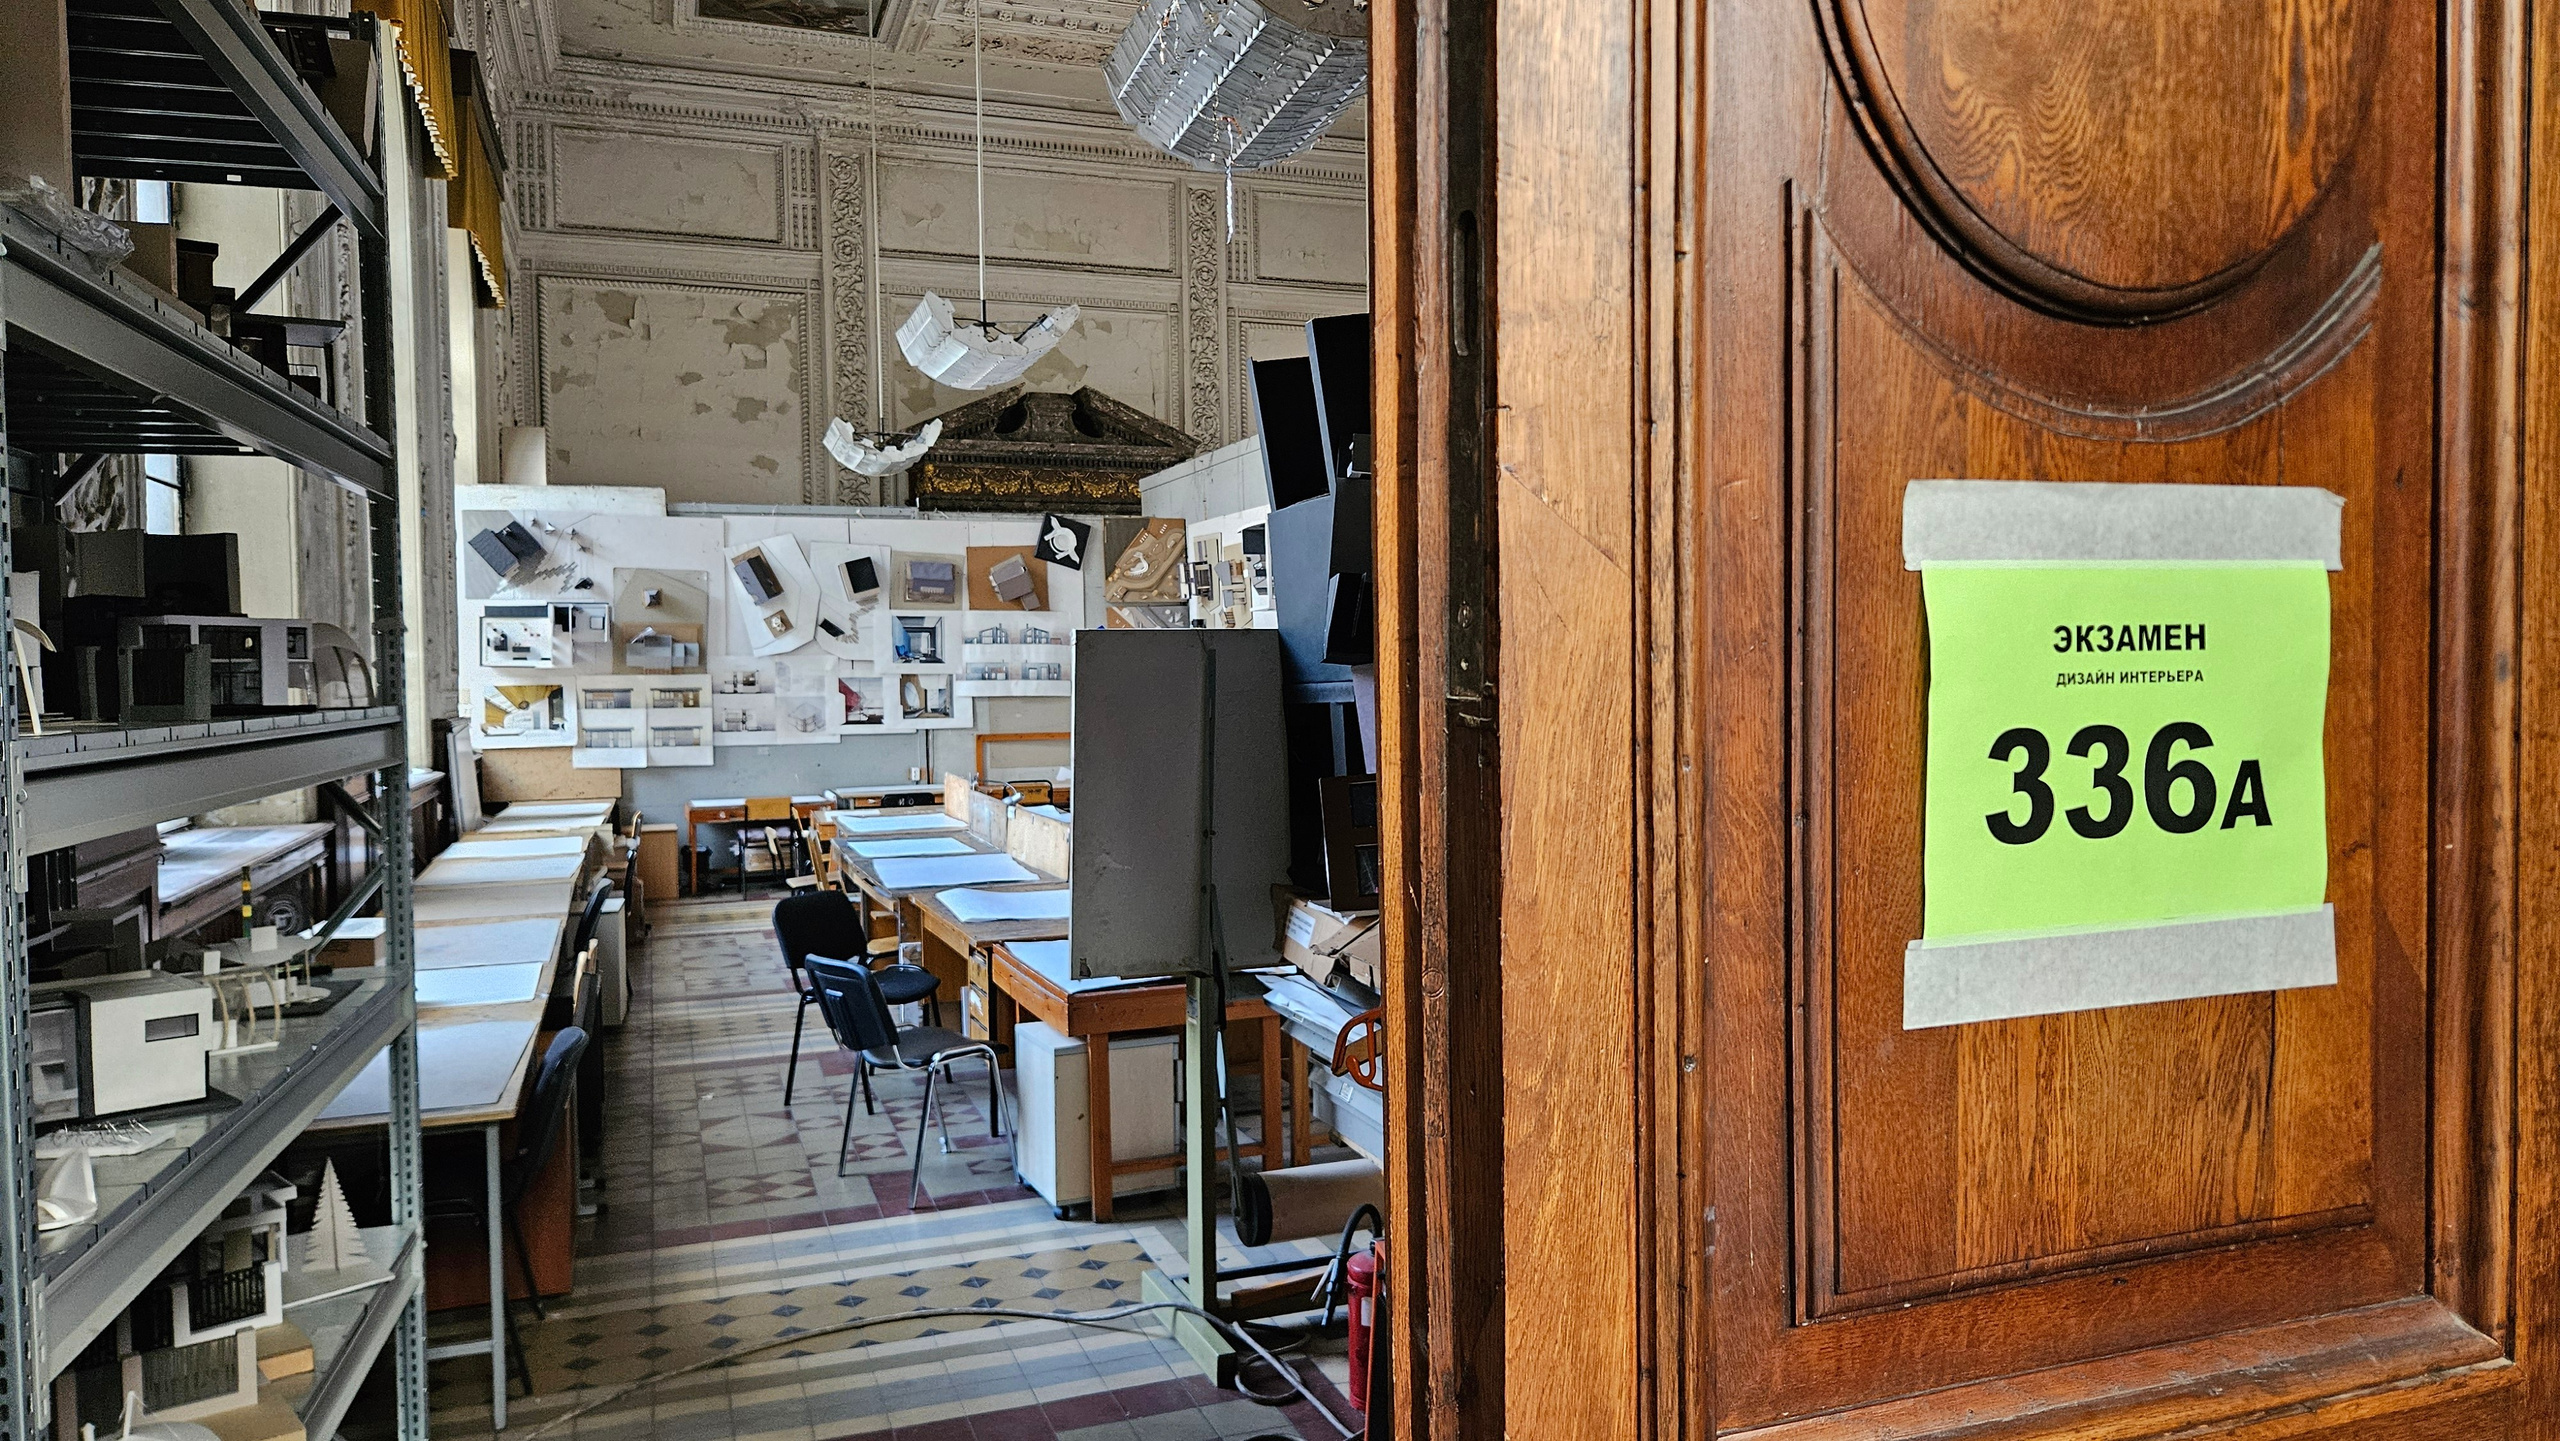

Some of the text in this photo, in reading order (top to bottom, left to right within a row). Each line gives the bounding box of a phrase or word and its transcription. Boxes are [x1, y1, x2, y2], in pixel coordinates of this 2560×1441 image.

[2053, 624, 2206, 653] ЭКЗАМЕН
[2056, 669, 2204, 687] ДИЗАЙН ИНТЕРЬЕРА
[1985, 721, 2273, 845] 336А
